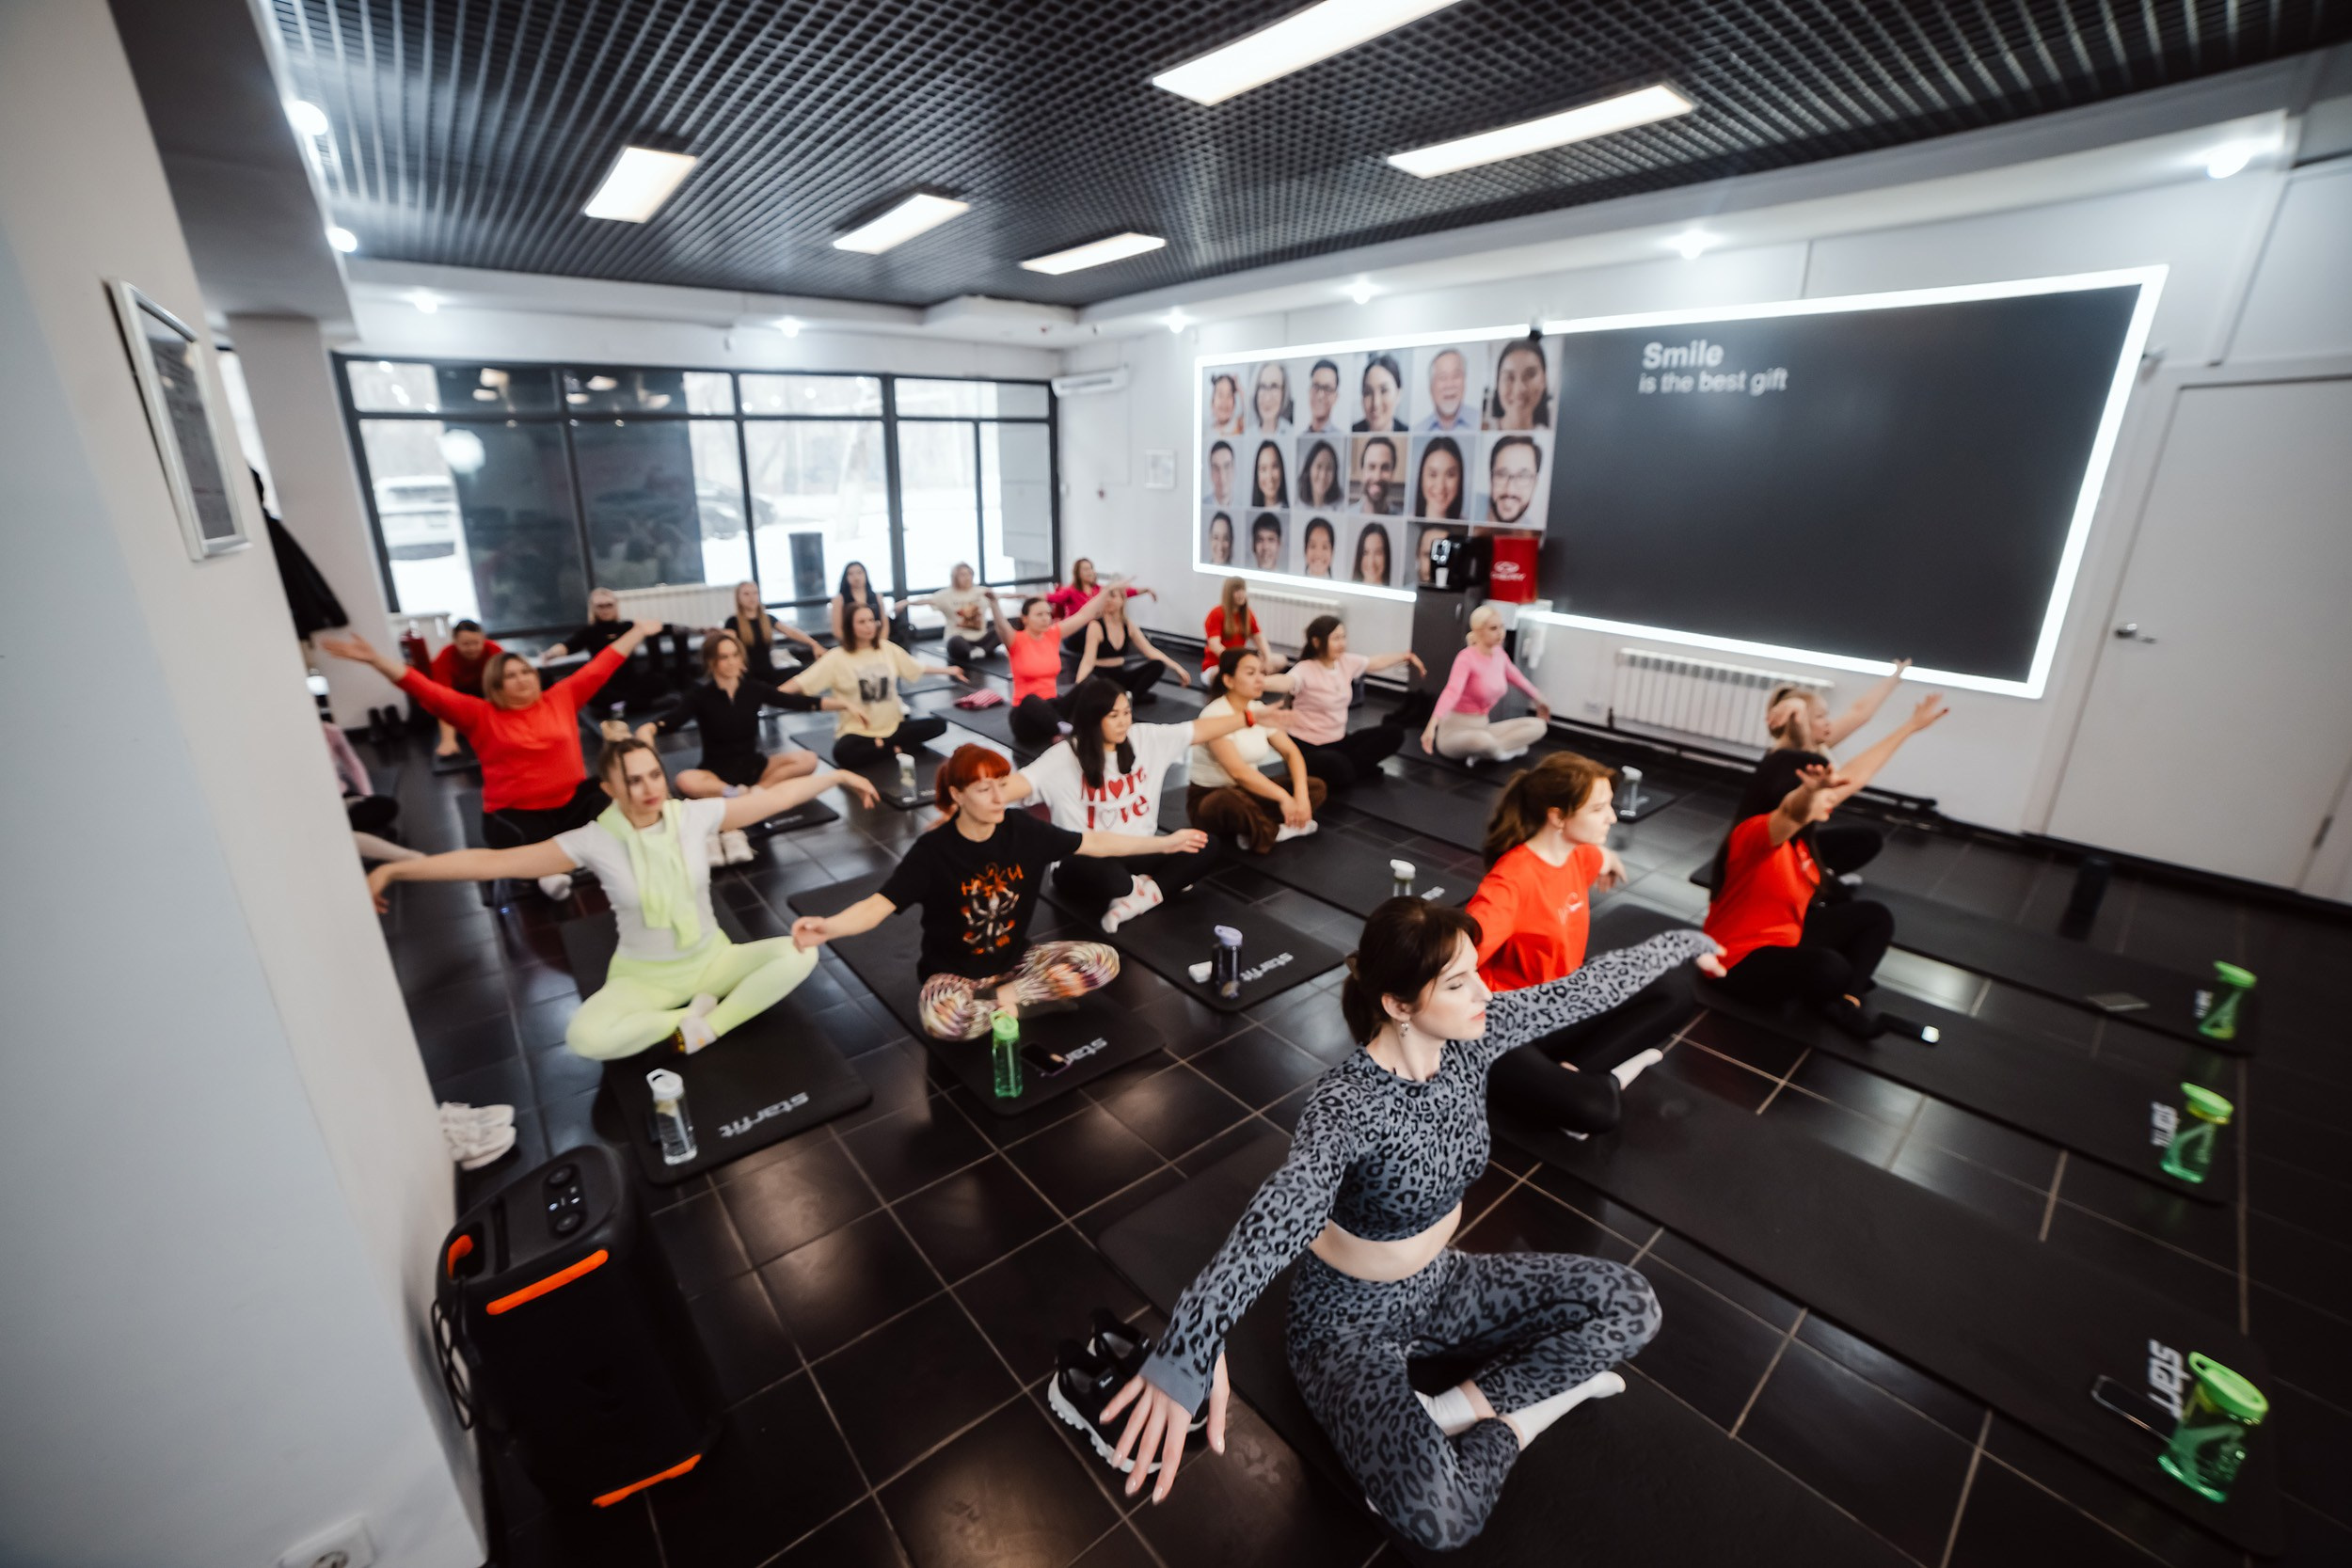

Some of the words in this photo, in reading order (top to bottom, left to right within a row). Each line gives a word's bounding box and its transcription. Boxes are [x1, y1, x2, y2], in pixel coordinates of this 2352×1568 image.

[1643, 340, 1724, 370] Smile
[1638, 372, 1657, 393] is
[1661, 372, 1694, 393] the
[1697, 370, 1747, 392] best
[1749, 367, 1788, 397] gift
[719, 1091, 810, 1137] starfit
